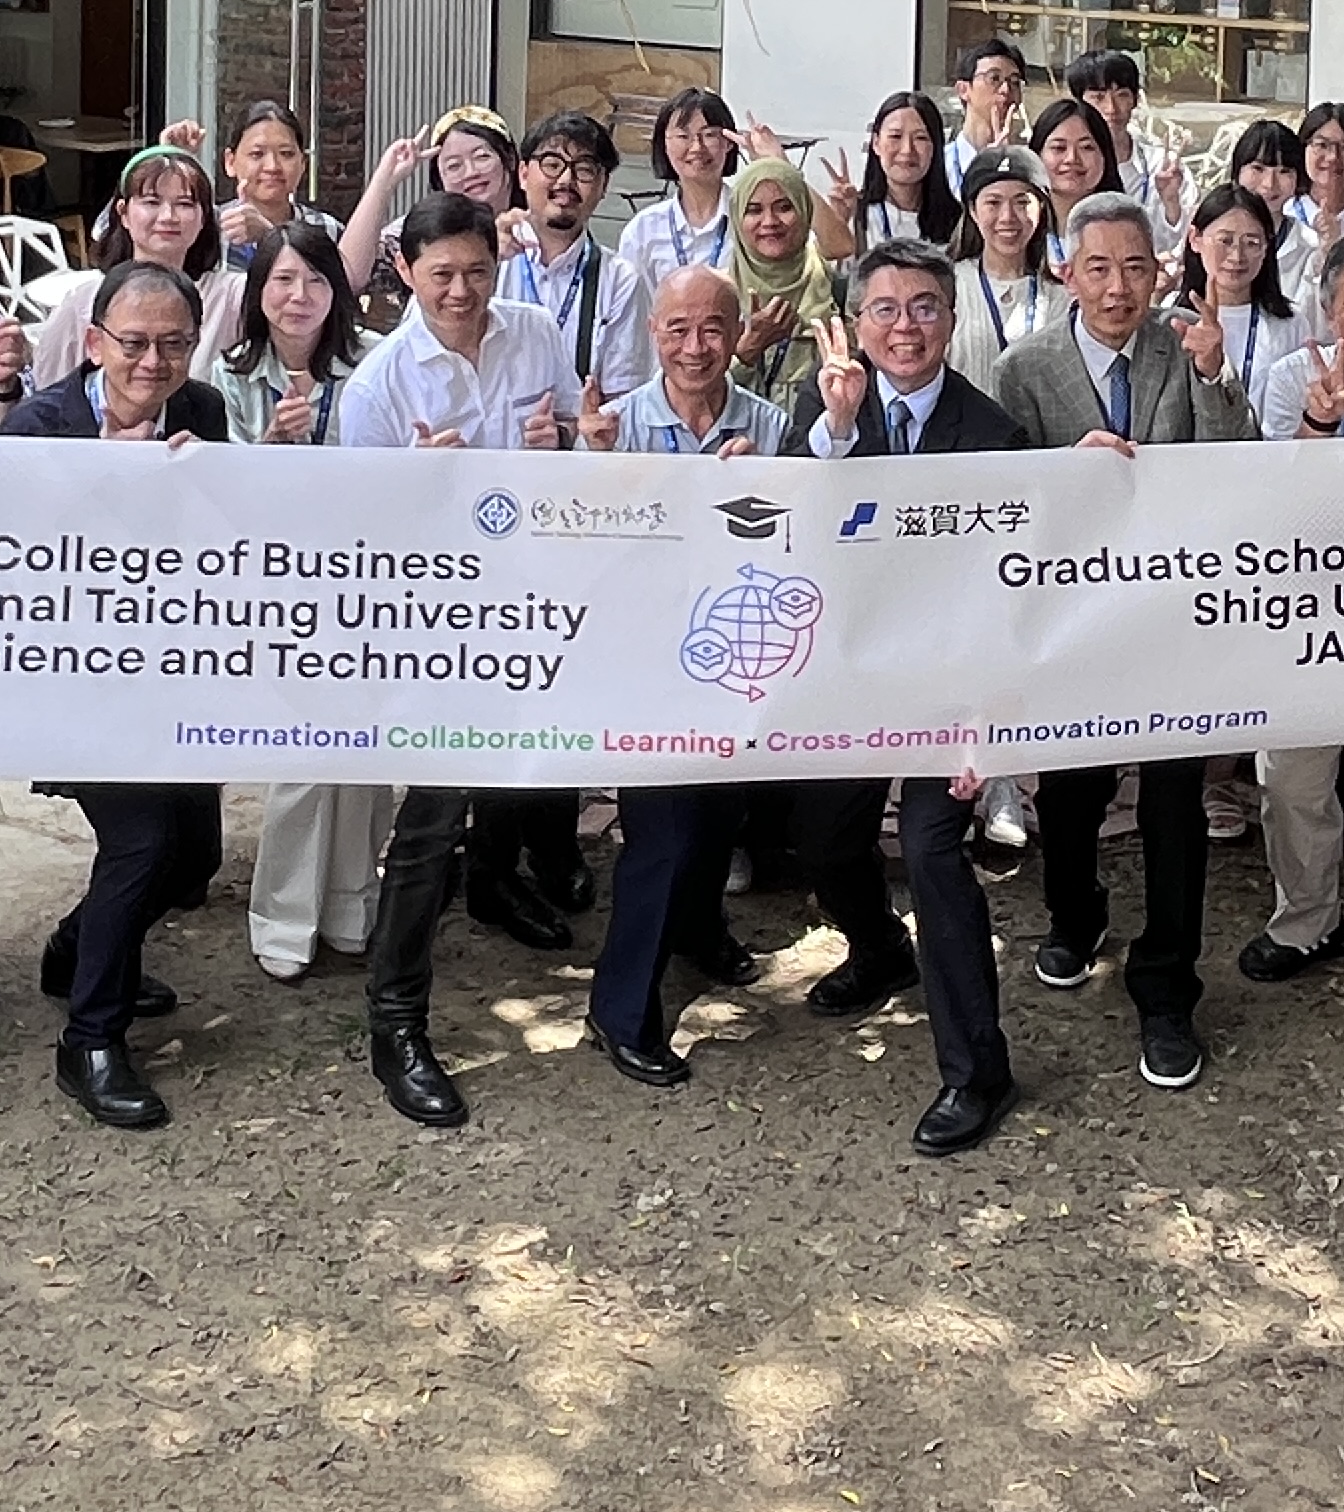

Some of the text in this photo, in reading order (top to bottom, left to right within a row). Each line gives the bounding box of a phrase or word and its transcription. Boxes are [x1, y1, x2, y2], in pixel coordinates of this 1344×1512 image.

[893, 499, 1031, 538] 滋賀大学
[196, 539, 250, 577] of
[261, 538, 482, 580] Business
[998, 546, 1224, 588] Graduate
[85, 584, 319, 639] Taichung
[336, 589, 589, 641] University
[1193, 586, 1319, 631] Shiga
[159, 640, 255, 677] and
[267, 641, 565, 691] Technology
[175, 721, 379, 749] International
[386, 724, 595, 753] Collaborative
[602, 728, 736, 758] Learning
[766, 722, 979, 753] Cross-domain
[987, 714, 1141, 745] Innovation
[1148, 708, 1268, 736] Program
